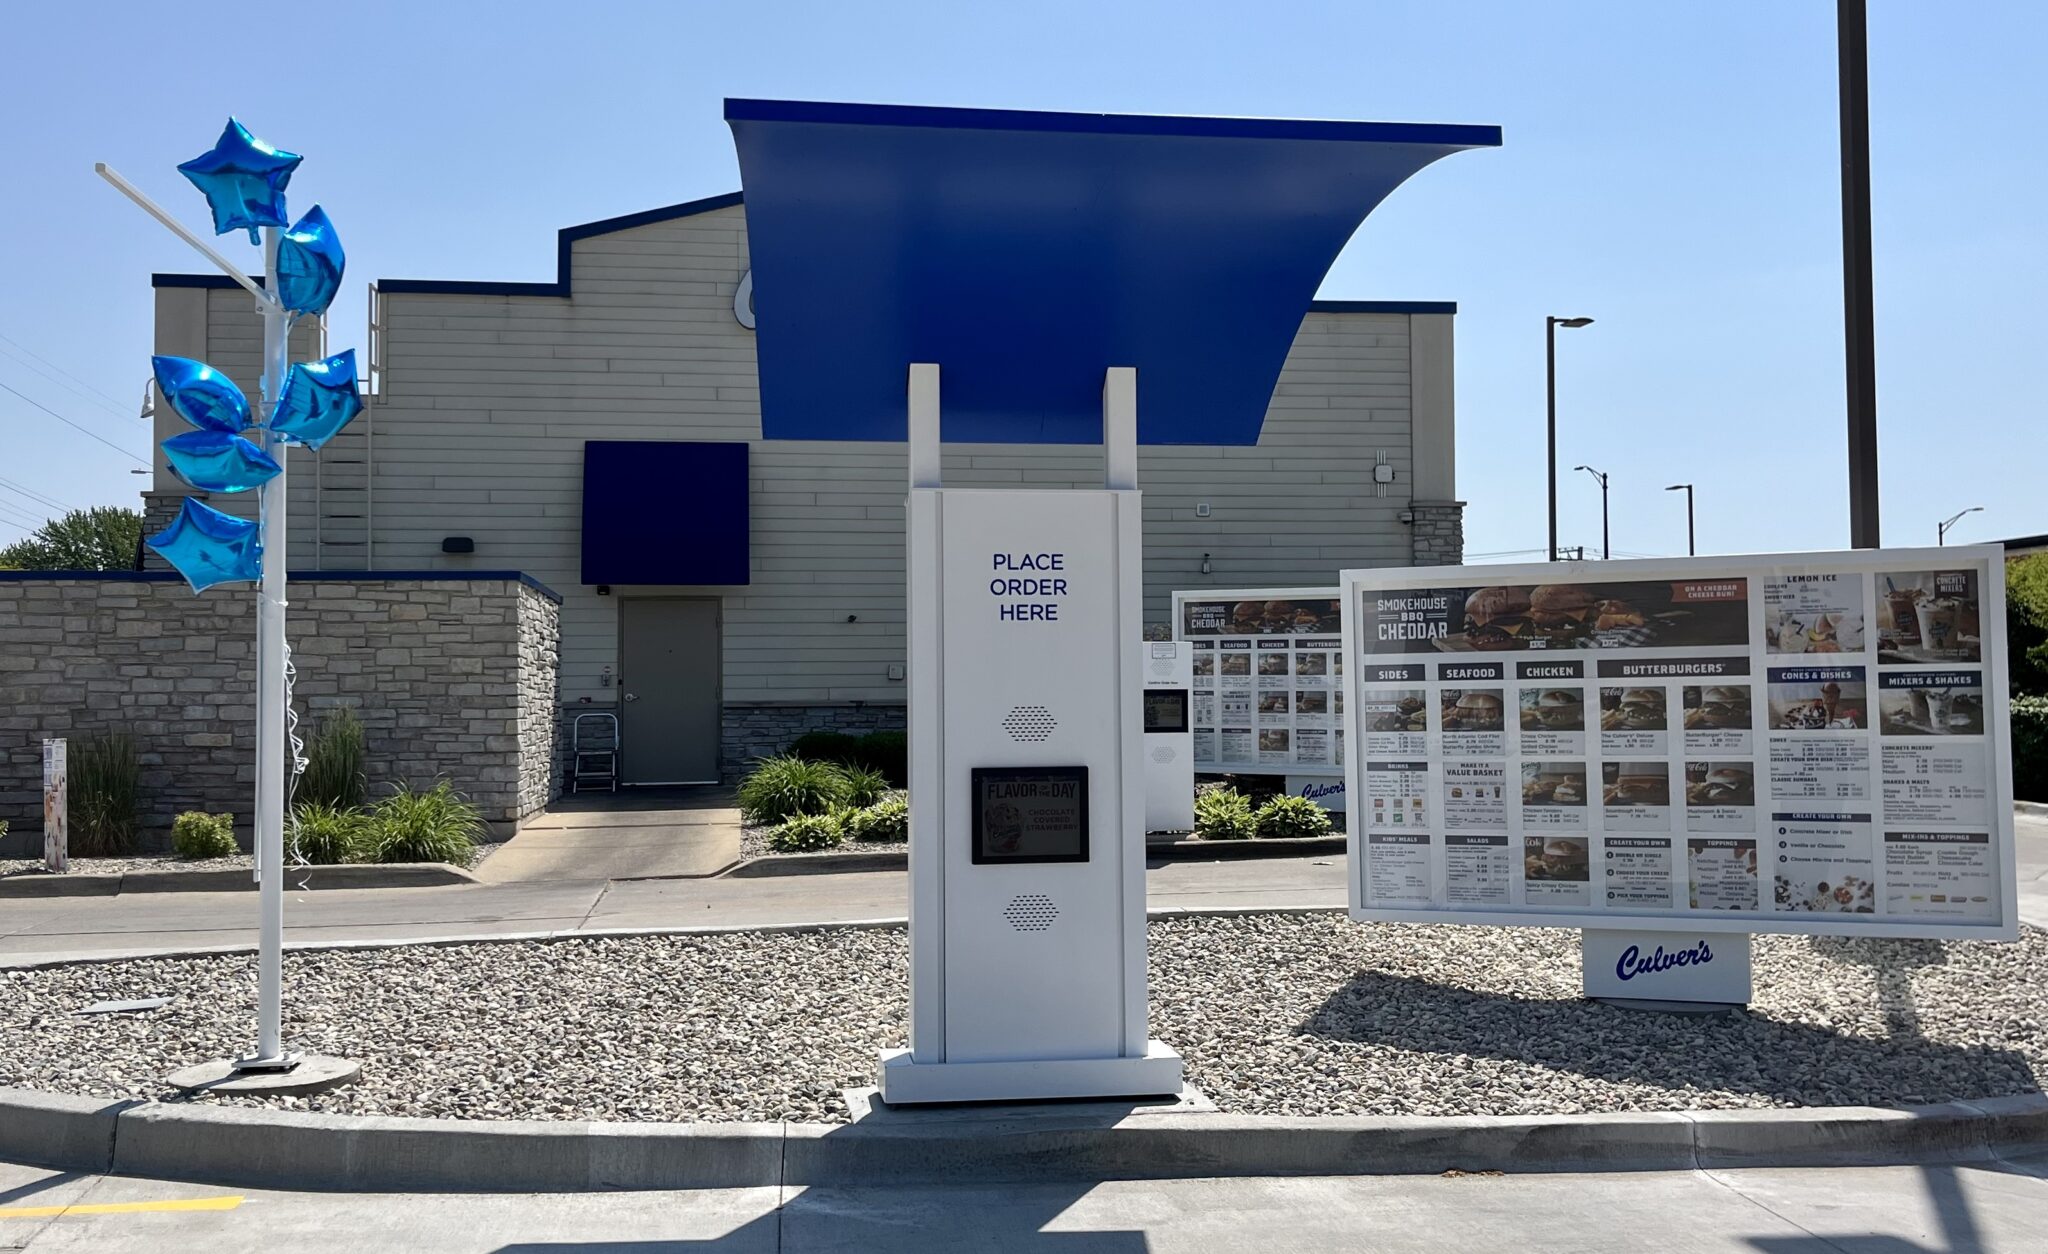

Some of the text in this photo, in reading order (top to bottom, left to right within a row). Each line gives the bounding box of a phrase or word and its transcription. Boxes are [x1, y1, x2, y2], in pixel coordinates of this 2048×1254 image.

[993, 553, 1064, 571] PLACE
[1787, 574, 1837, 583] LEMON ICE
[990, 578, 1067, 596] ORDER
[1703, 584, 1737, 592] CHEDDAR
[1688, 591, 1715, 599] CHEESE
[1191, 605, 1226, 613] SMOKEHOUSE
[1377, 597, 1448, 612] SMOKEHOUSE
[1000, 604, 1058, 621] HERE
[1401, 612, 1424, 622] BBQ
[1191, 618, 1226, 629] CHEDDAR
[1378, 621, 1448, 641] CHEDDAR
[1378, 670, 1409, 680] SIDES
[1446, 668, 1496, 678] SEAFOOD
[1526, 666, 1574, 677] CHICKEN
[1781, 671, 1852, 680] CONES & DISHES
[1888, 676, 1972, 686] MIXERS & SHAKES
[987, 783, 1038, 800] FLAVOR
[1051, 782, 1076, 799] DAY
[1028, 808, 1075, 816] CHOCOLATE
[1033, 816, 1070, 824] COVERED
[1025, 824, 1079, 832] STRAWBERRY
[1616, 940, 1714, 981] Culver's
